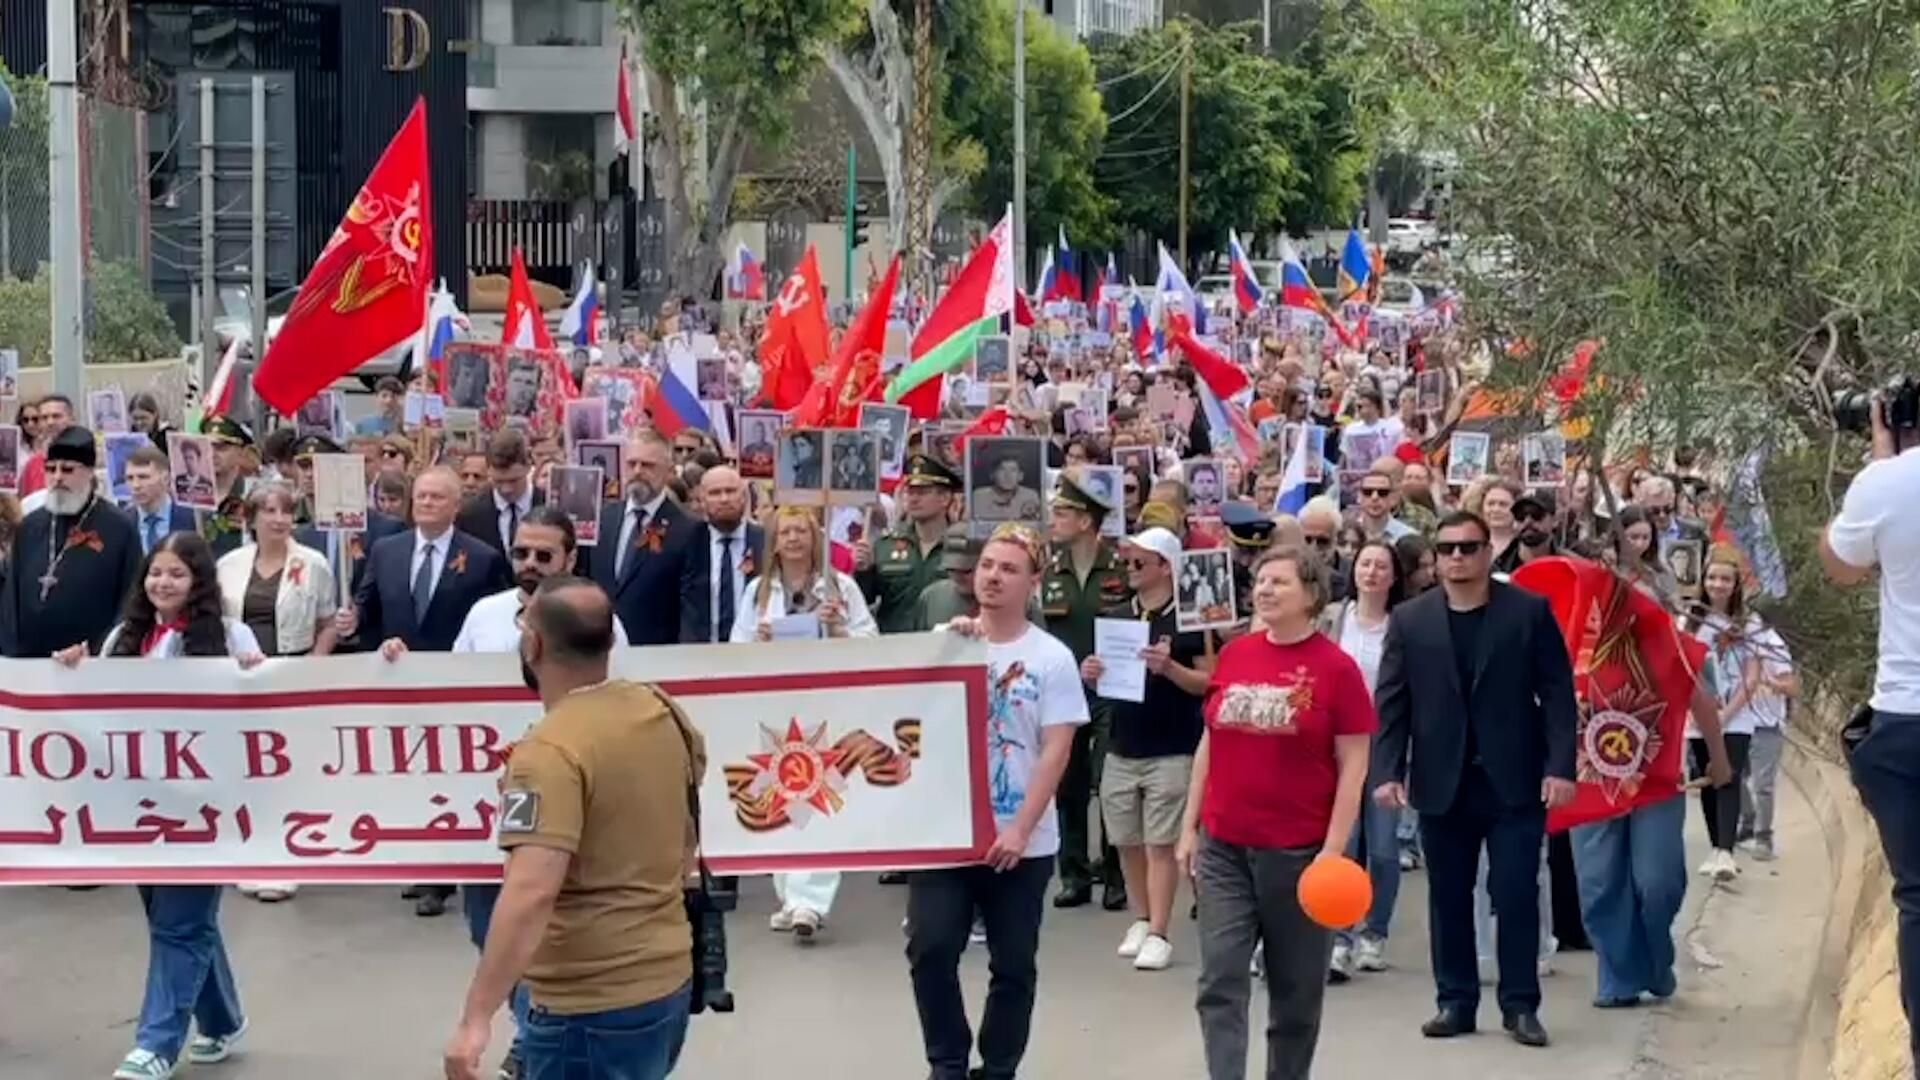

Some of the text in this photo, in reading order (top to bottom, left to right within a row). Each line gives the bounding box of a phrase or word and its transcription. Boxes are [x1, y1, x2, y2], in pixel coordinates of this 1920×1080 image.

[242, 729, 292, 779] В
[322, 724, 502, 776] ЛИВ
[0, 794, 497, 857] لفوج الخال
[502, 792, 529, 827] Z
